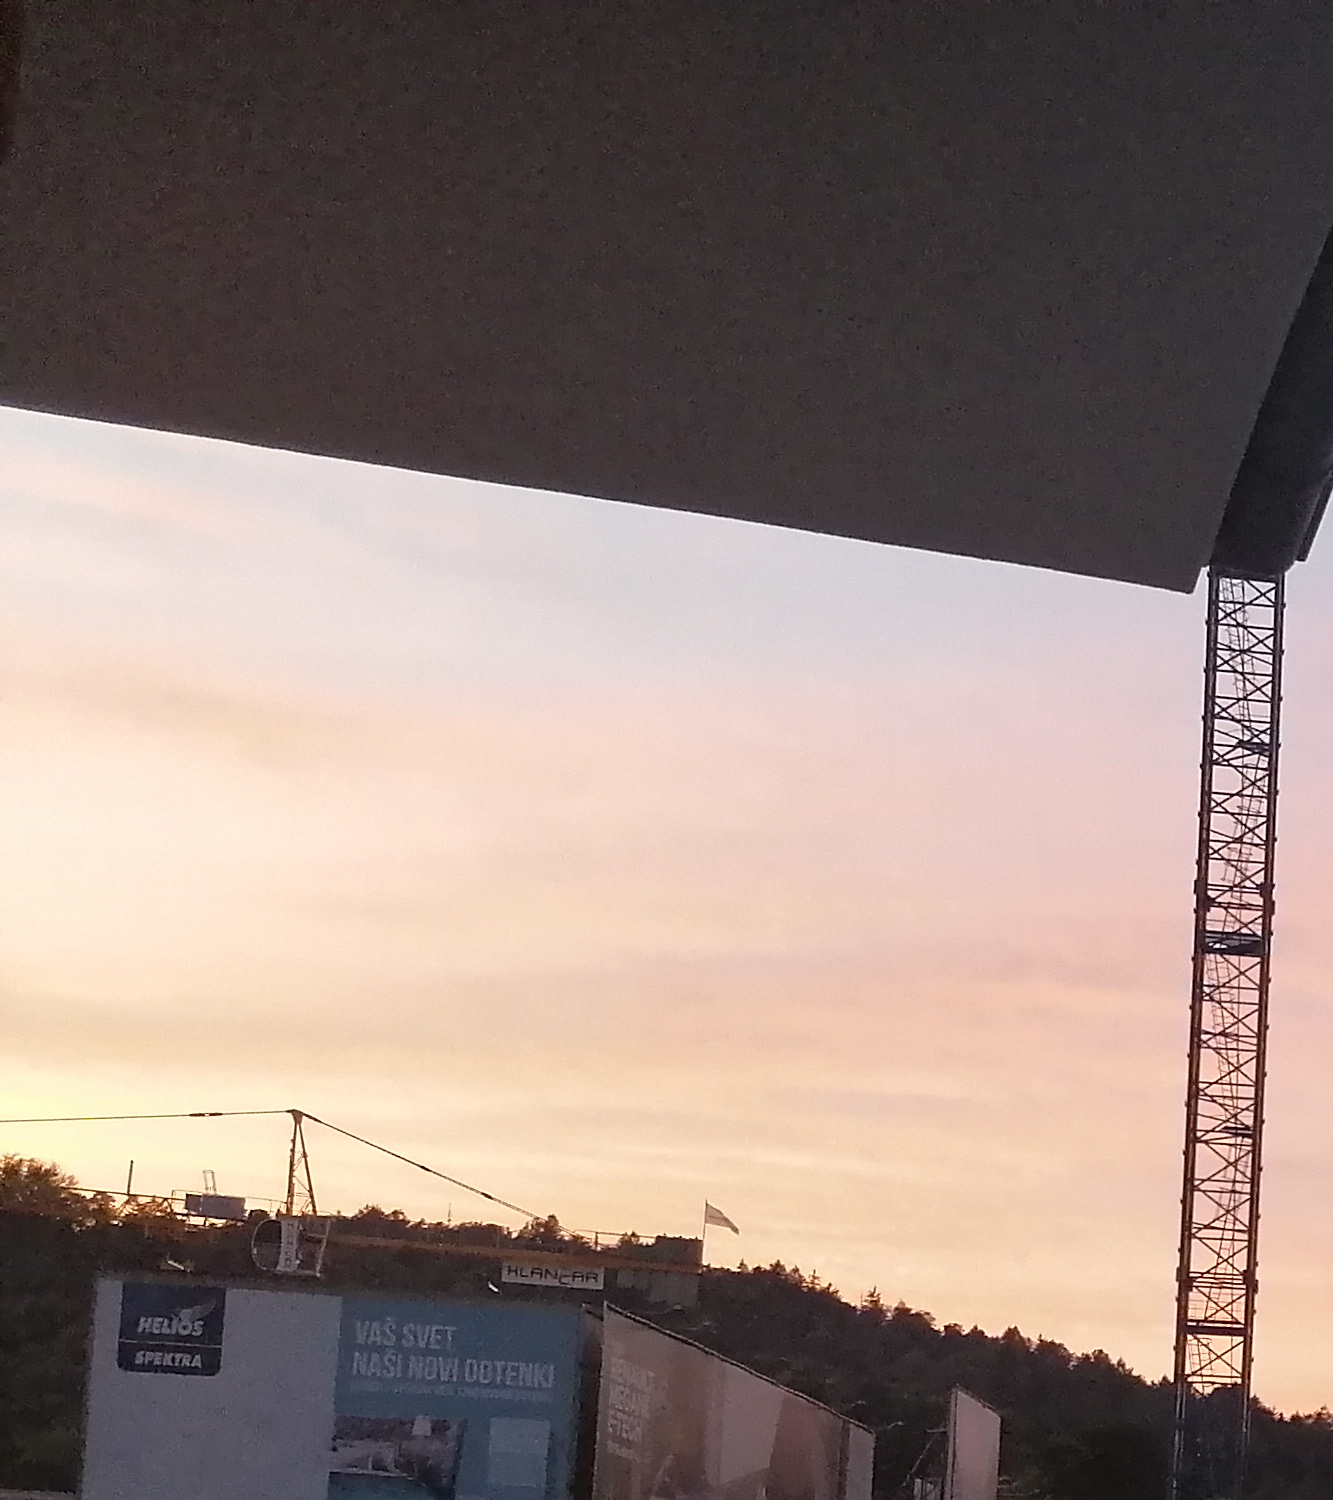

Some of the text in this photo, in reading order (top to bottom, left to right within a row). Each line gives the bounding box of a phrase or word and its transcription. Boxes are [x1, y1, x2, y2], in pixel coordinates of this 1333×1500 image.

[137, 1315, 205, 1337] HELIOS
[356, 1317, 457, 1350] VAŠ SVET
[134, 1350, 202, 1370] SPEKTRA
[352, 1347, 556, 1389] NAŠI NOVI ODTENKI
